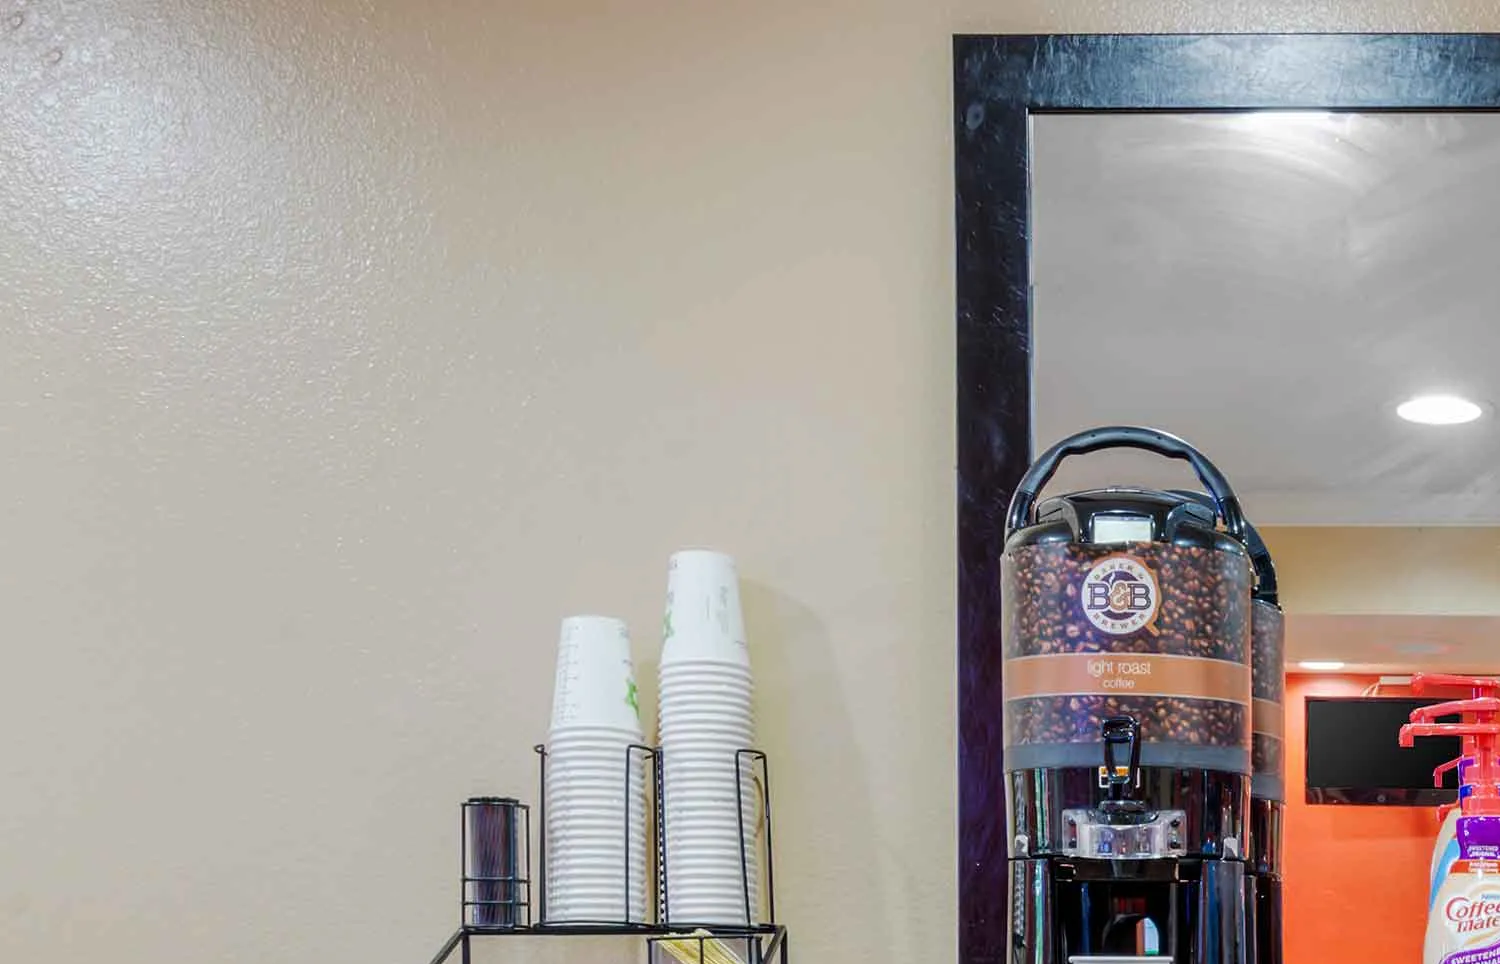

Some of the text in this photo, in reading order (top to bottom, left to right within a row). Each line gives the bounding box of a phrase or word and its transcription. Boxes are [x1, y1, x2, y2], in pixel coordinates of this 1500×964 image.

[1087, 581, 1152, 612] B&B
[1086, 659, 1152, 678] light roast
[1103, 679, 1135, 689] coffee
